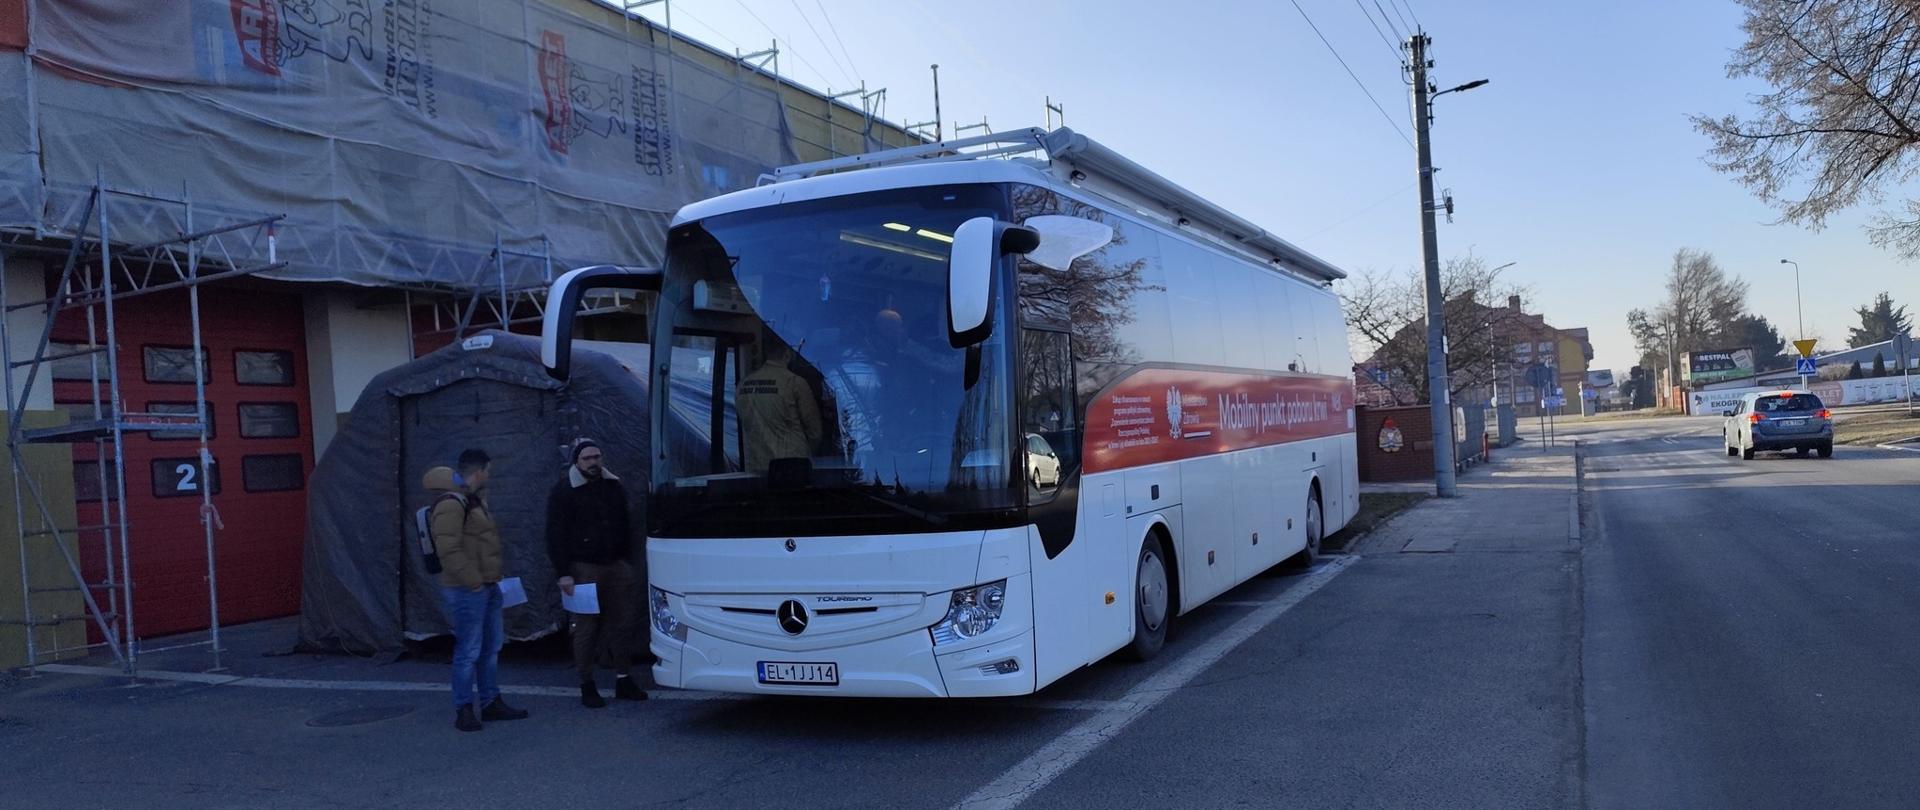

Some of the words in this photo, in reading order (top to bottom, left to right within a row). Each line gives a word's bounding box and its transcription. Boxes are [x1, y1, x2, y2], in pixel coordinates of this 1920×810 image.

[631, 65, 644, 165] prawdziwy
[640, 68, 663, 176] STYROPIAN
[1218, 392, 1259, 434] Mobilny
[1261, 392, 1286, 434] punkt
[1287, 392, 1313, 432] poboru
[175, 463, 198, 491] 2
[816, 595, 873, 603] TOURISMO
